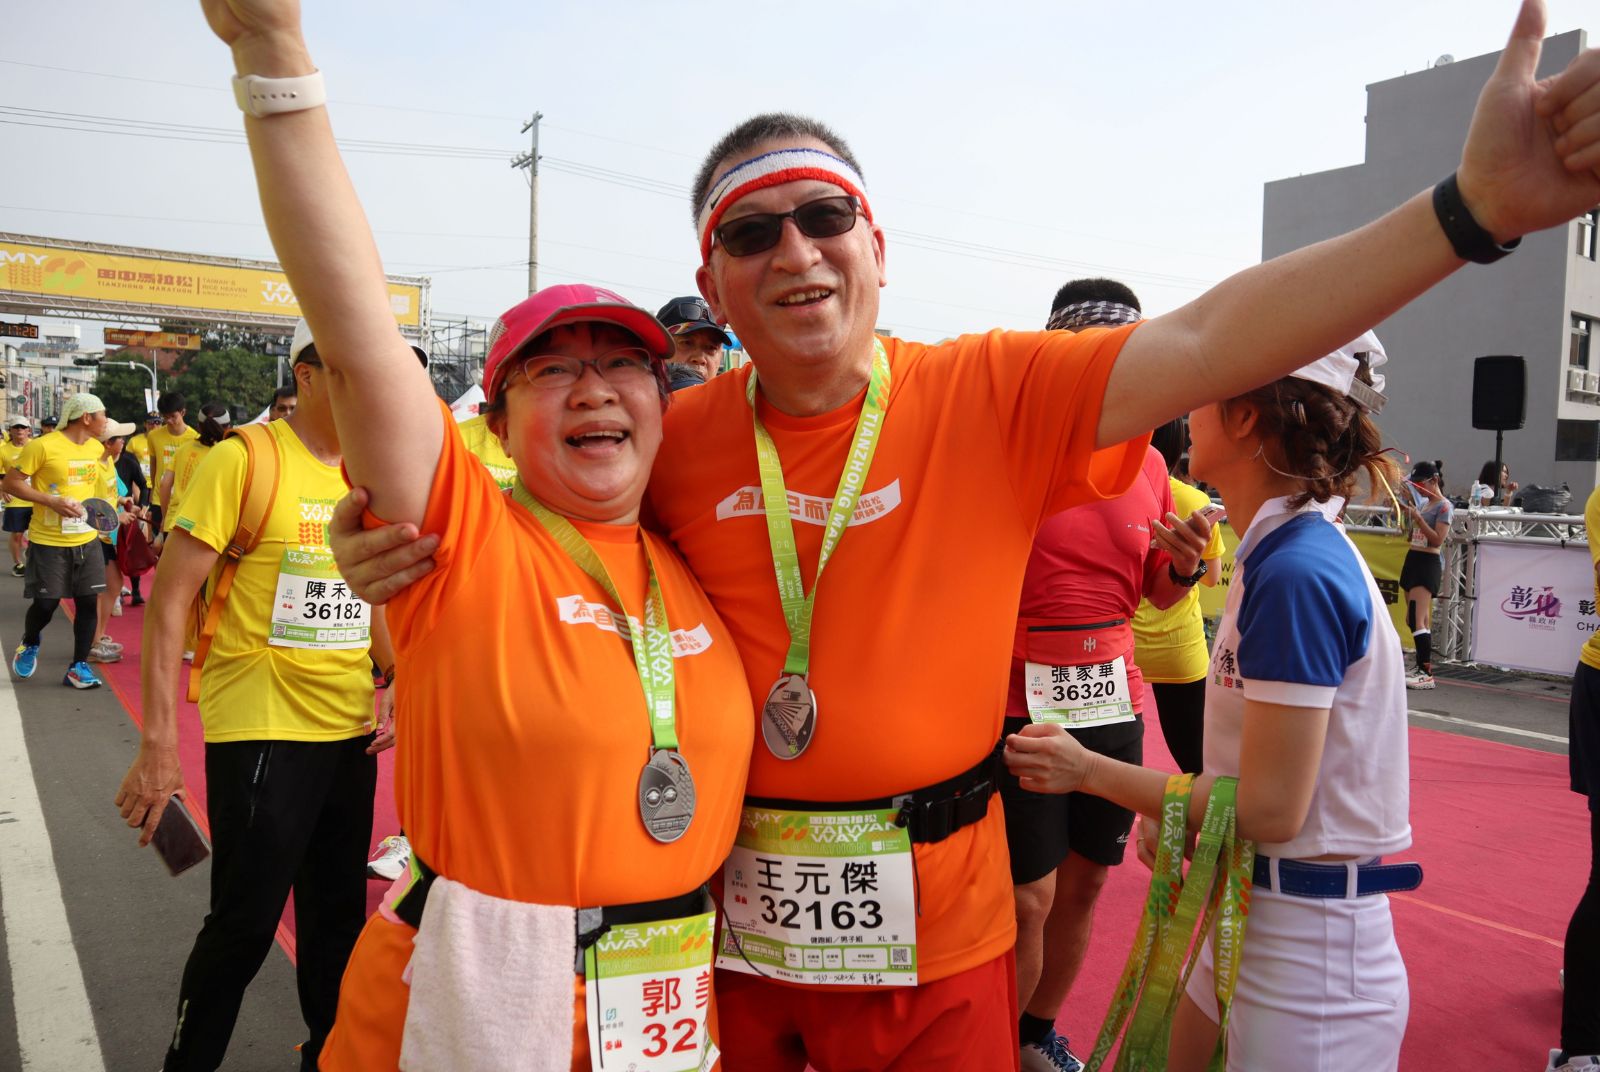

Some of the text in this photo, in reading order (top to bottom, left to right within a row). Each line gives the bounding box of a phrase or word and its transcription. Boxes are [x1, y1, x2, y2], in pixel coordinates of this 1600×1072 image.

[261, 280, 292, 292] TA
[818, 413, 879, 571] TIANZHONG MARA
[300, 511, 333, 521] WA
[774, 561, 787, 599] TAIWAN'S
[786, 579, 795, 599] RICE
[793, 566, 804, 598] HEAVEN
[303, 602, 362, 620] 36182
[645, 598, 662, 687] TAIWAN
[656, 631, 673, 687] WAY
[1051, 664, 1114, 684] 張家華
[1052, 680, 1115, 702] 36320
[810, 822, 897, 834] TAIWAN
[1163, 801, 1175, 850] WAY
[1201, 795, 1216, 832] TAIWAN'S
[811, 832, 863, 843] WAY
[1171, 801, 1185, 877] IT'S MY
[755, 858, 878, 895] 王元傑
[759, 895, 883, 930] 32163
[597, 938, 652, 952] WAY
[607, 924, 683, 941] T'S MY
[1218, 904, 1233, 993] TIANZHONG
[641, 1017, 698, 1058] 32
